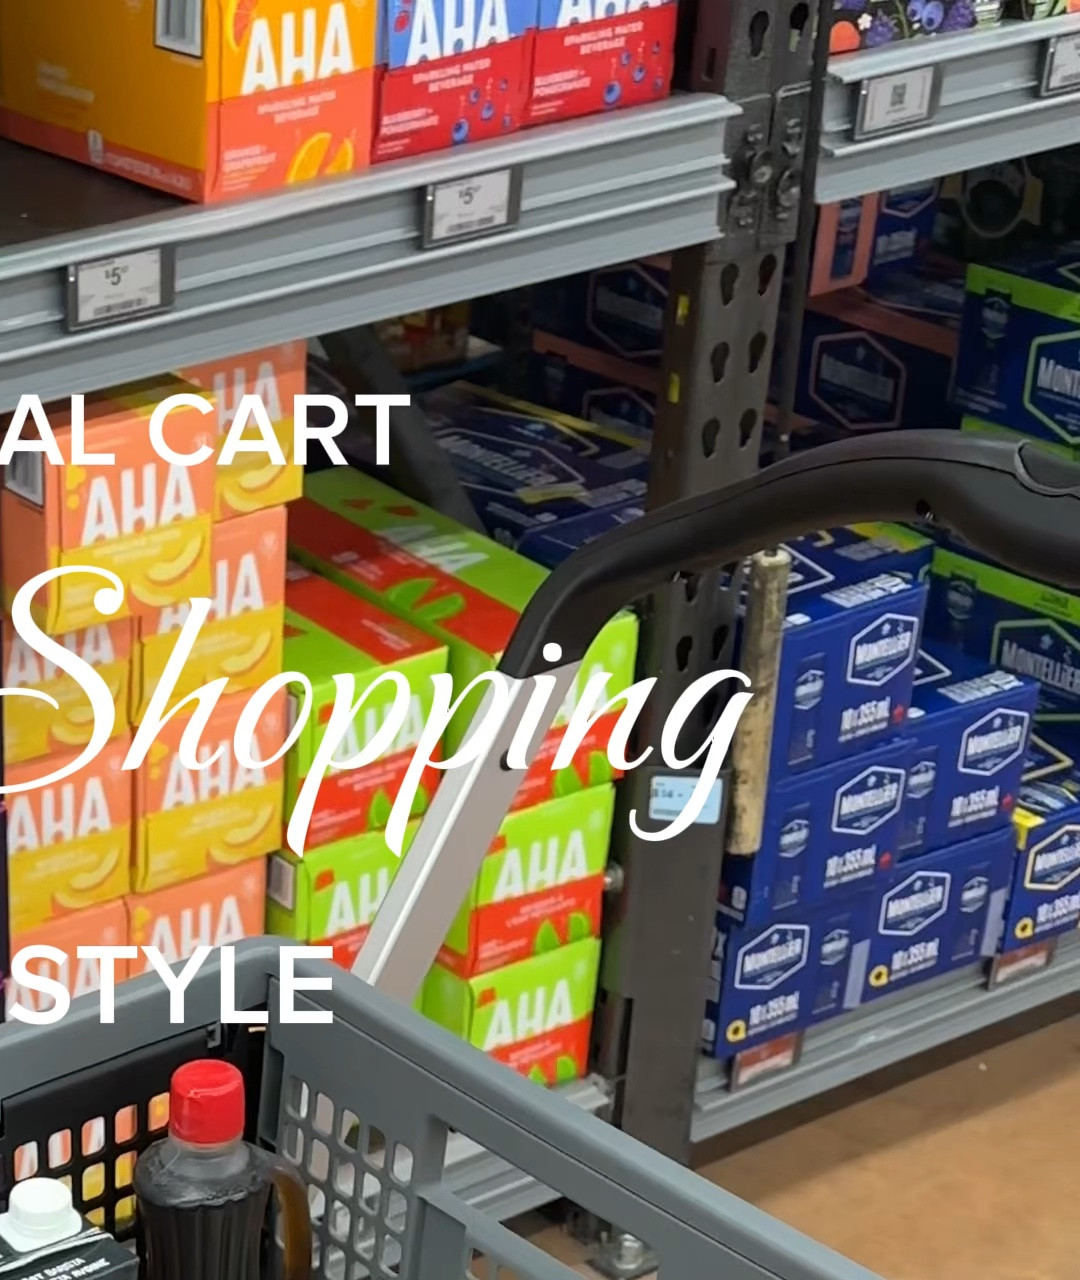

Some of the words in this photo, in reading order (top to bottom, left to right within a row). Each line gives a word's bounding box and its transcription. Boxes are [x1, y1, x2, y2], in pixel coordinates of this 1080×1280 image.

[241, 3, 354, 95] AHA
[81, 462, 197, 547] AHA
[7, 776, 111, 854] AHA
[494, 828, 589, 900] AHA
[325, 867, 391, 937] AH
[484, 978, 573, 1051] AHA
